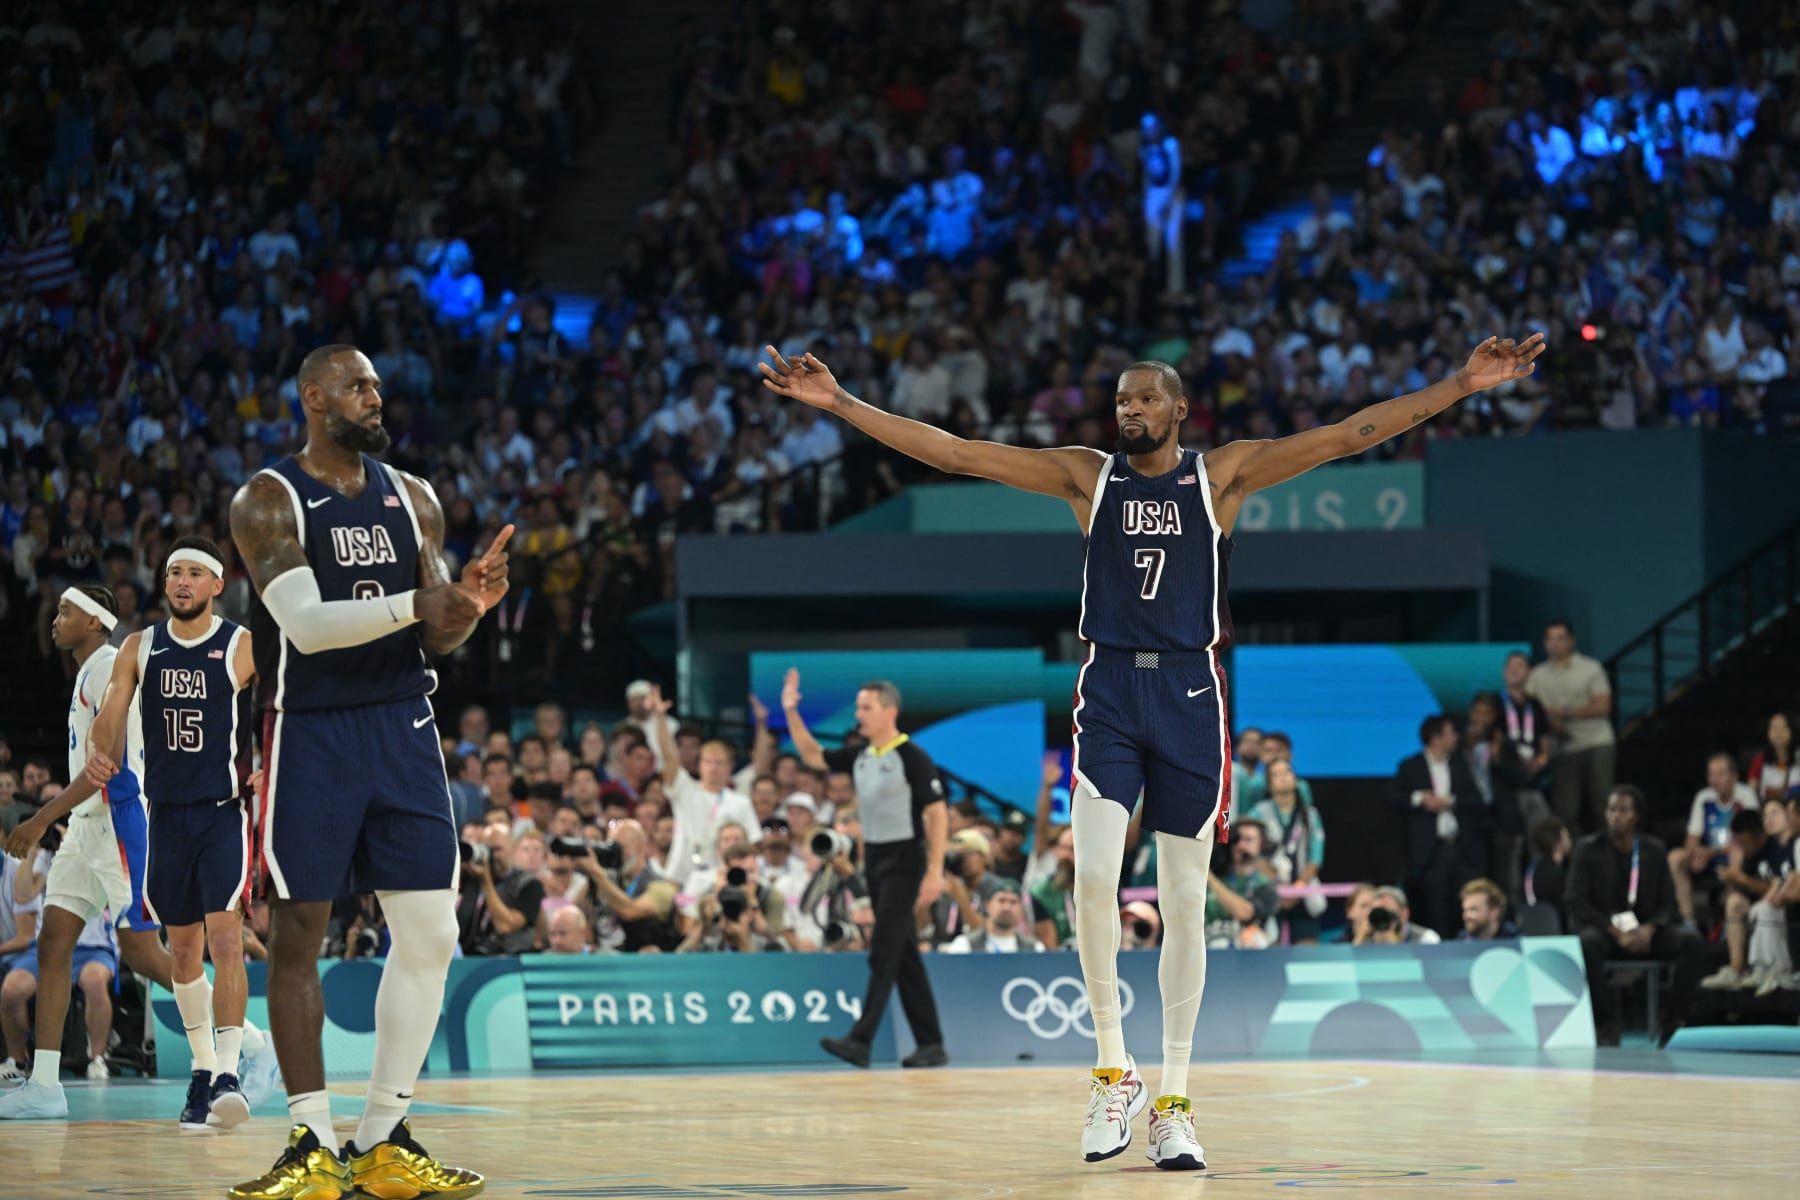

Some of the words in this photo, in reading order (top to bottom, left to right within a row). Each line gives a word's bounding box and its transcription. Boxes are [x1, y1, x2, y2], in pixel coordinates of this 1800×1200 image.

[1123, 500, 1182, 535] USA
[1240, 492, 1345, 531] RIS
[330, 525, 397, 567] USA
[1134, 548, 1166, 600] 7
[160, 668, 207, 700] USA
[163, 708, 203, 752] 15
[727, 989, 862, 1024] 2024
